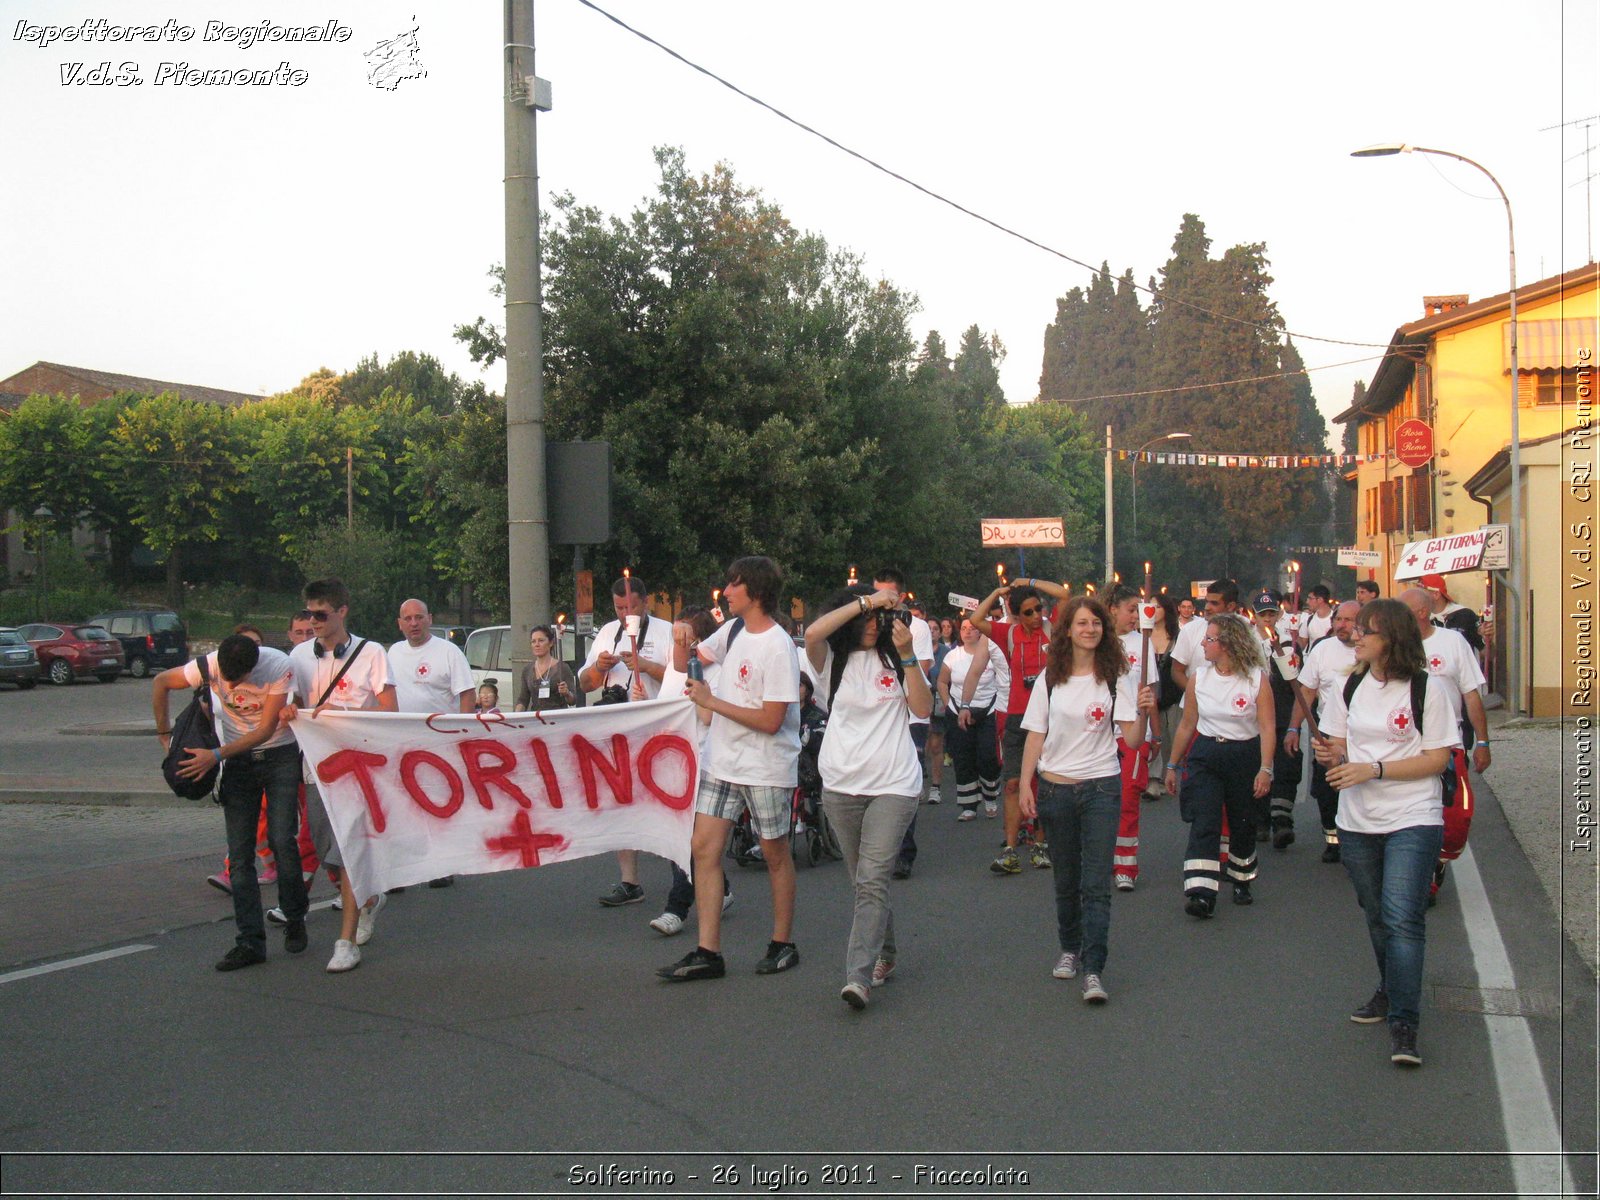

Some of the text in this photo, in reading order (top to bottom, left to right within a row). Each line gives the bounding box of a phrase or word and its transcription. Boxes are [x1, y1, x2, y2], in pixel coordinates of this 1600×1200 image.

[1401, 427, 1424, 437] Rosa
[1401, 442, 1427, 452] Remo
[1426, 532, 1484, 553] GATTORNA
[1423, 554, 1478, 571] GE ITALY
[317, 733, 698, 834] TORINO
